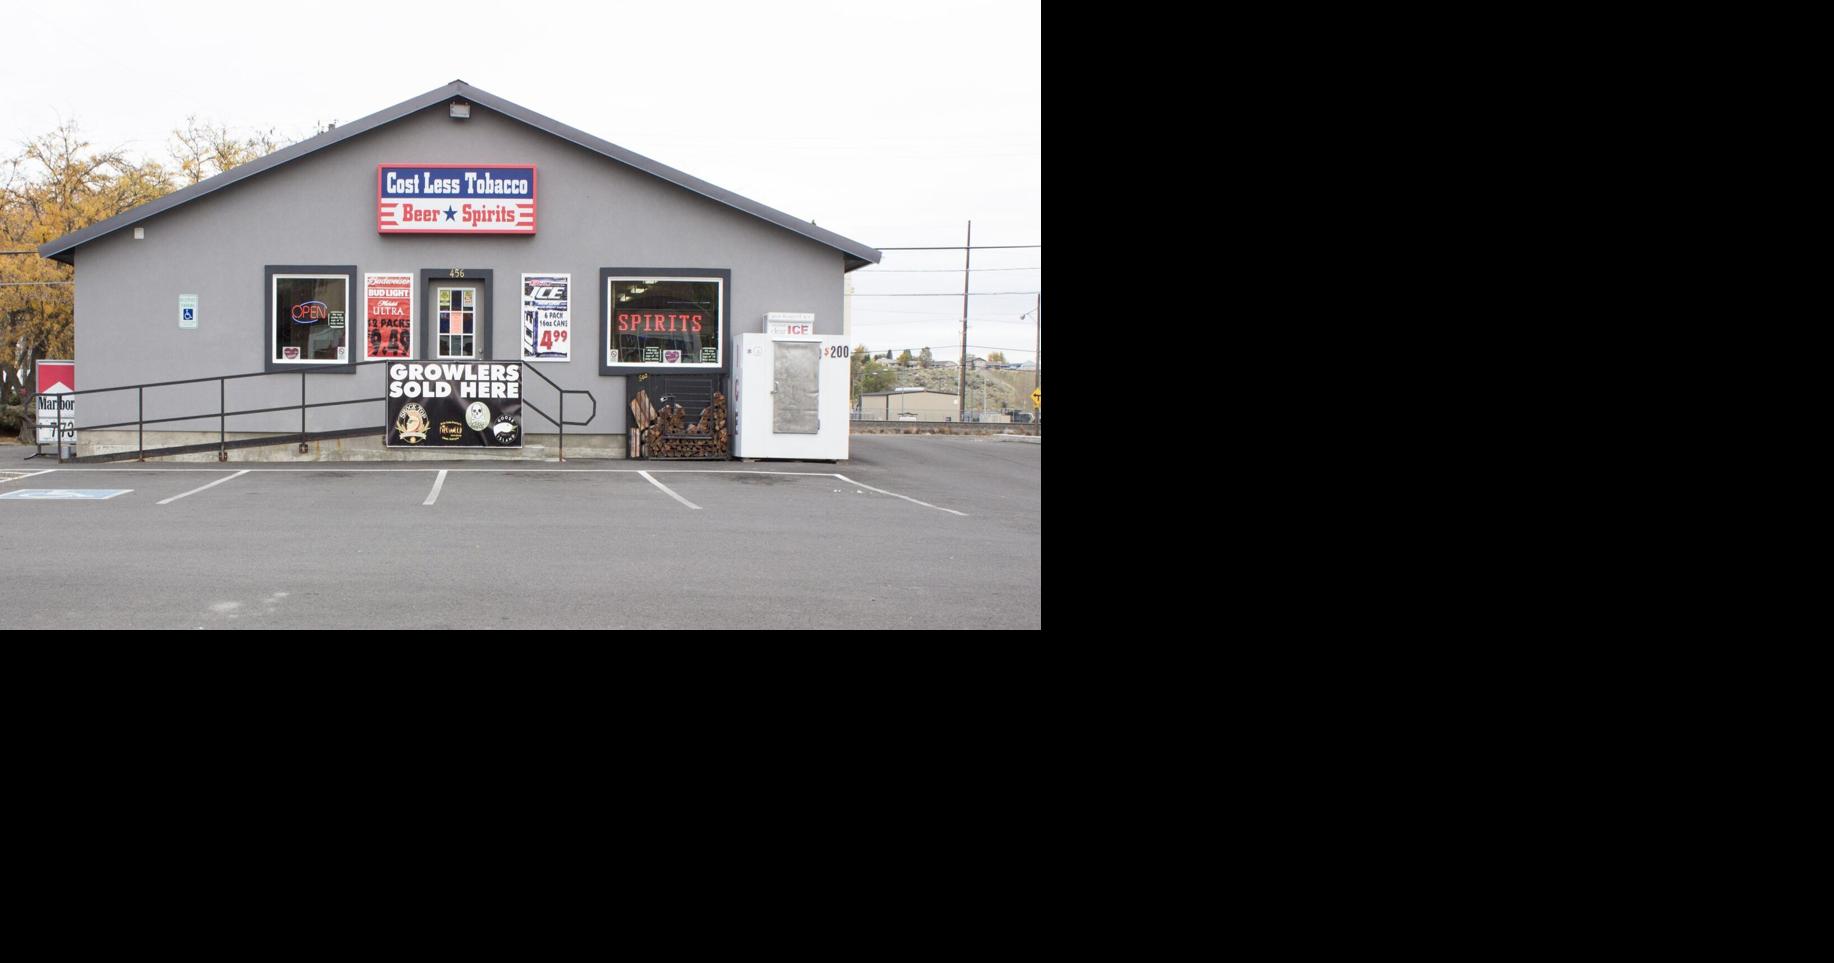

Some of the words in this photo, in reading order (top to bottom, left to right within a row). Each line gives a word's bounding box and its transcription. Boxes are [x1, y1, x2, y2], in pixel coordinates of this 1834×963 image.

[387, 172, 419, 193] Cost
[424, 172, 460, 194] Less
[465, 172, 528, 194] Tobacco
[402, 203, 440, 222] Beer
[462, 204, 515, 227] Spirits
[449, 268, 465, 278] 456
[368, 289, 385, 297] BUD
[386, 289, 409, 297] LIGHT
[530, 286, 565, 299] ICE
[291, 304, 327, 319] OPEN
[373, 306, 404, 316] ULTRA
[380, 319, 410, 328] PACKS
[618, 313, 703, 332] SPIRITS
[787, 325, 809, 335] ICE
[390, 363, 520, 381] GROWLERS
[389, 381, 452, 398] SOLD
[460, 382, 519, 398] HERE
